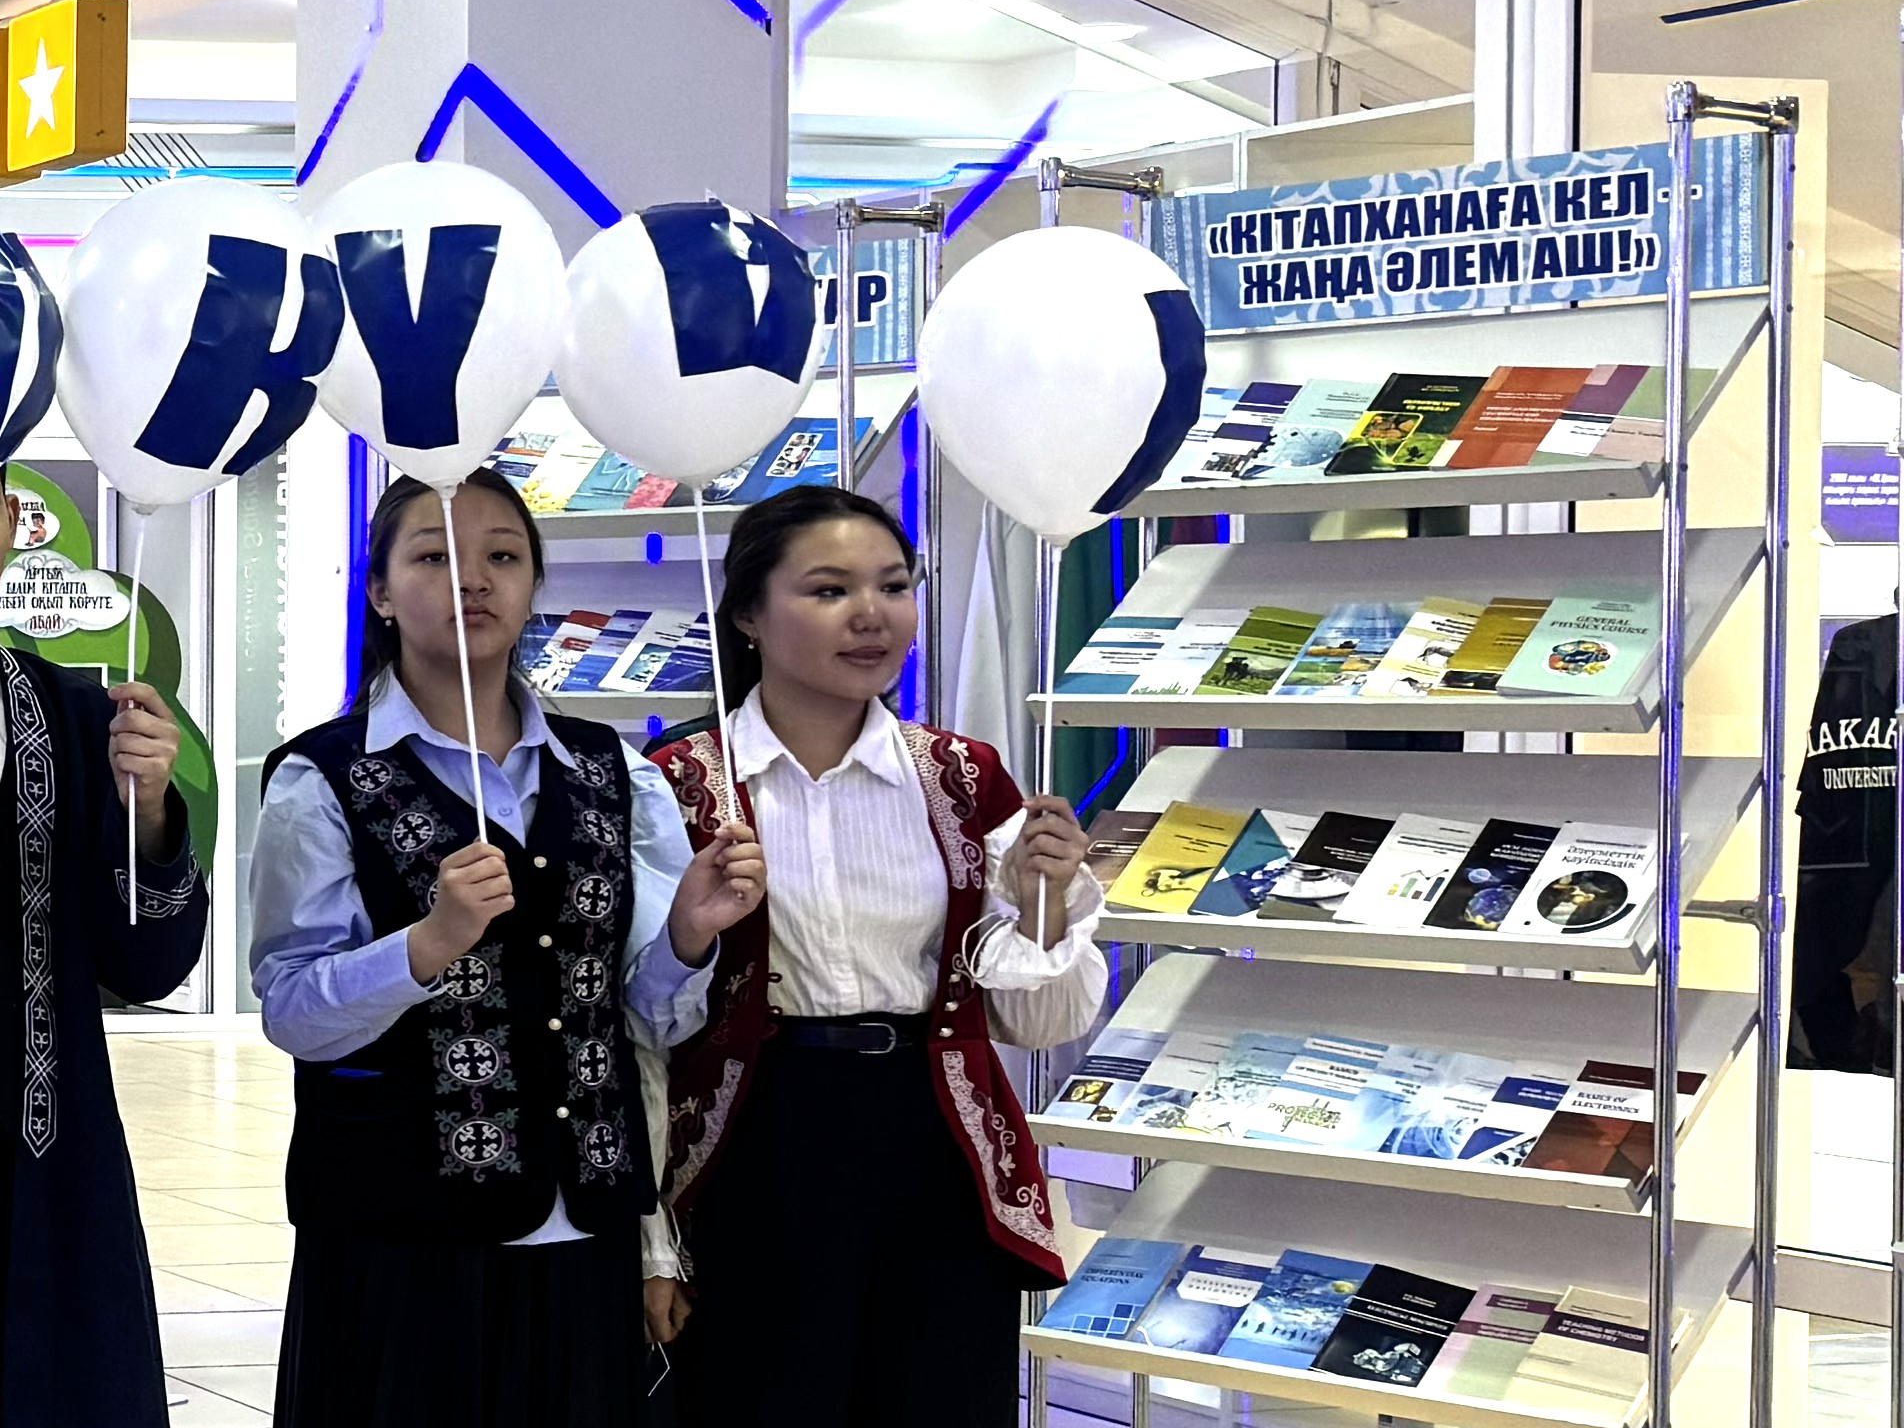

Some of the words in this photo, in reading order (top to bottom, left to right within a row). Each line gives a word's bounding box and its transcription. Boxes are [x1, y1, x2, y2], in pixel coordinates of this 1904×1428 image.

[1209, 190, 1540, 256] «КІТАПХАНАҒА
[1555, 172, 1649, 222] КЕЛ
[1242, 254, 1373, 307] ЖАҢА
[1386, 238, 1520, 291] ӘЛЕМ
[1531, 230, 1659, 282] АШ!»
